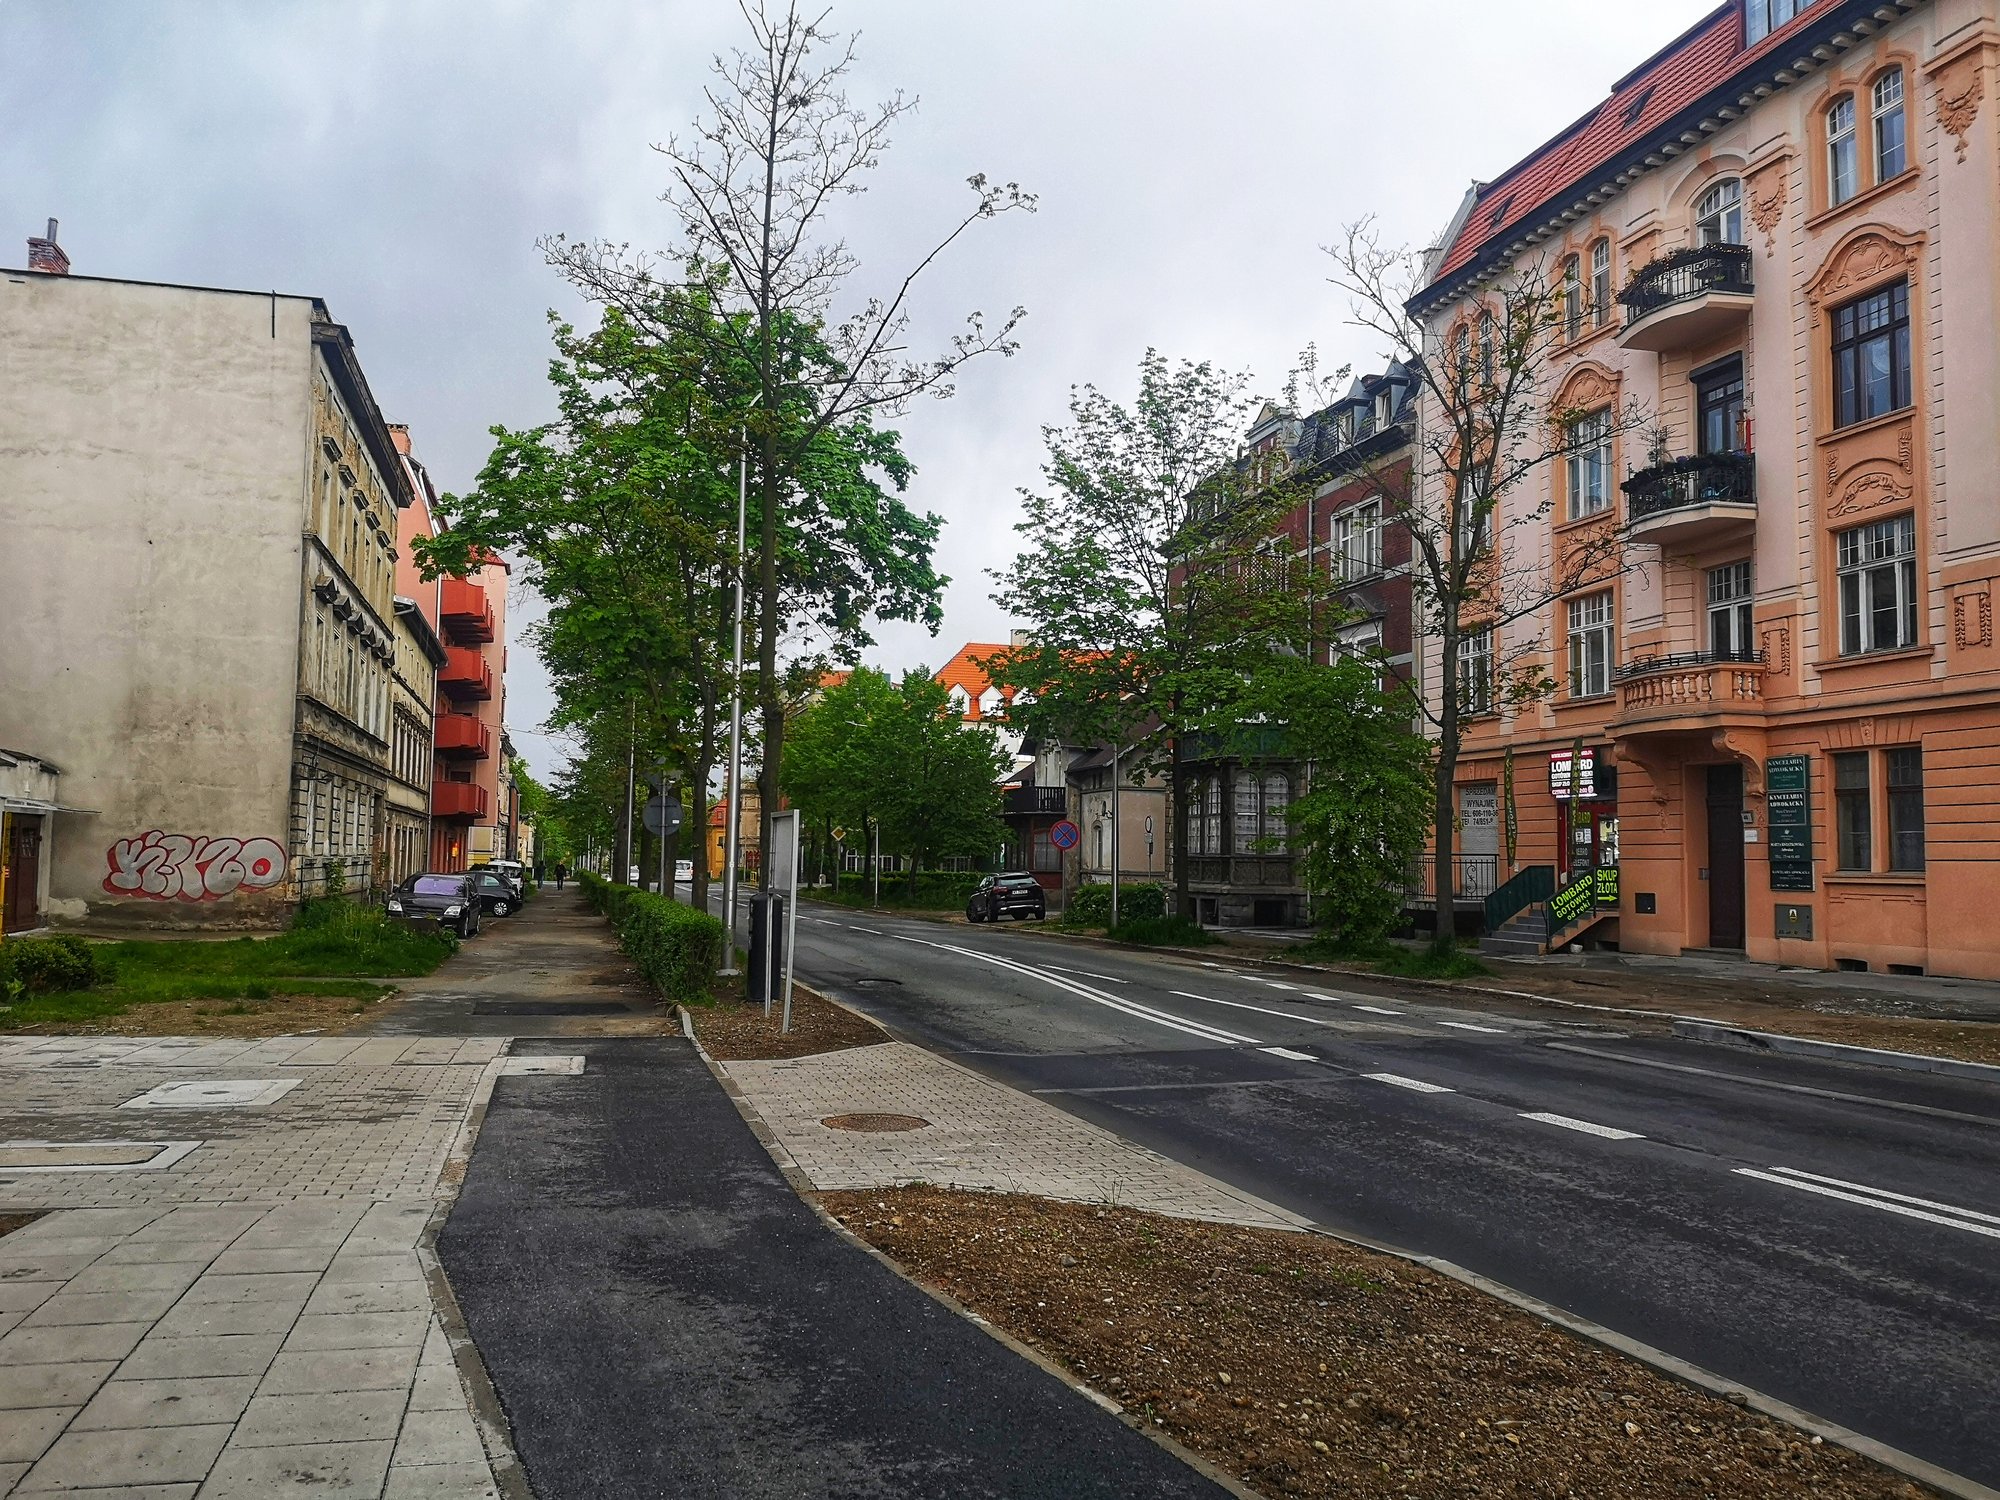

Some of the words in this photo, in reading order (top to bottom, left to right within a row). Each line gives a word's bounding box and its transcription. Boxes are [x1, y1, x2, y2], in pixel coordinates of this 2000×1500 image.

[1551, 759, 1593, 772] LOMRD
[1768, 758, 1803, 766] KANCELARIA
[1769, 793, 1803, 801] KANCELARIA
[1597, 869, 1618, 881] SKUP
[1551, 875, 1593, 910] LOMBARD
[1597, 882, 1618, 893] ZŁOTA
[1567, 910, 1576, 921] od
